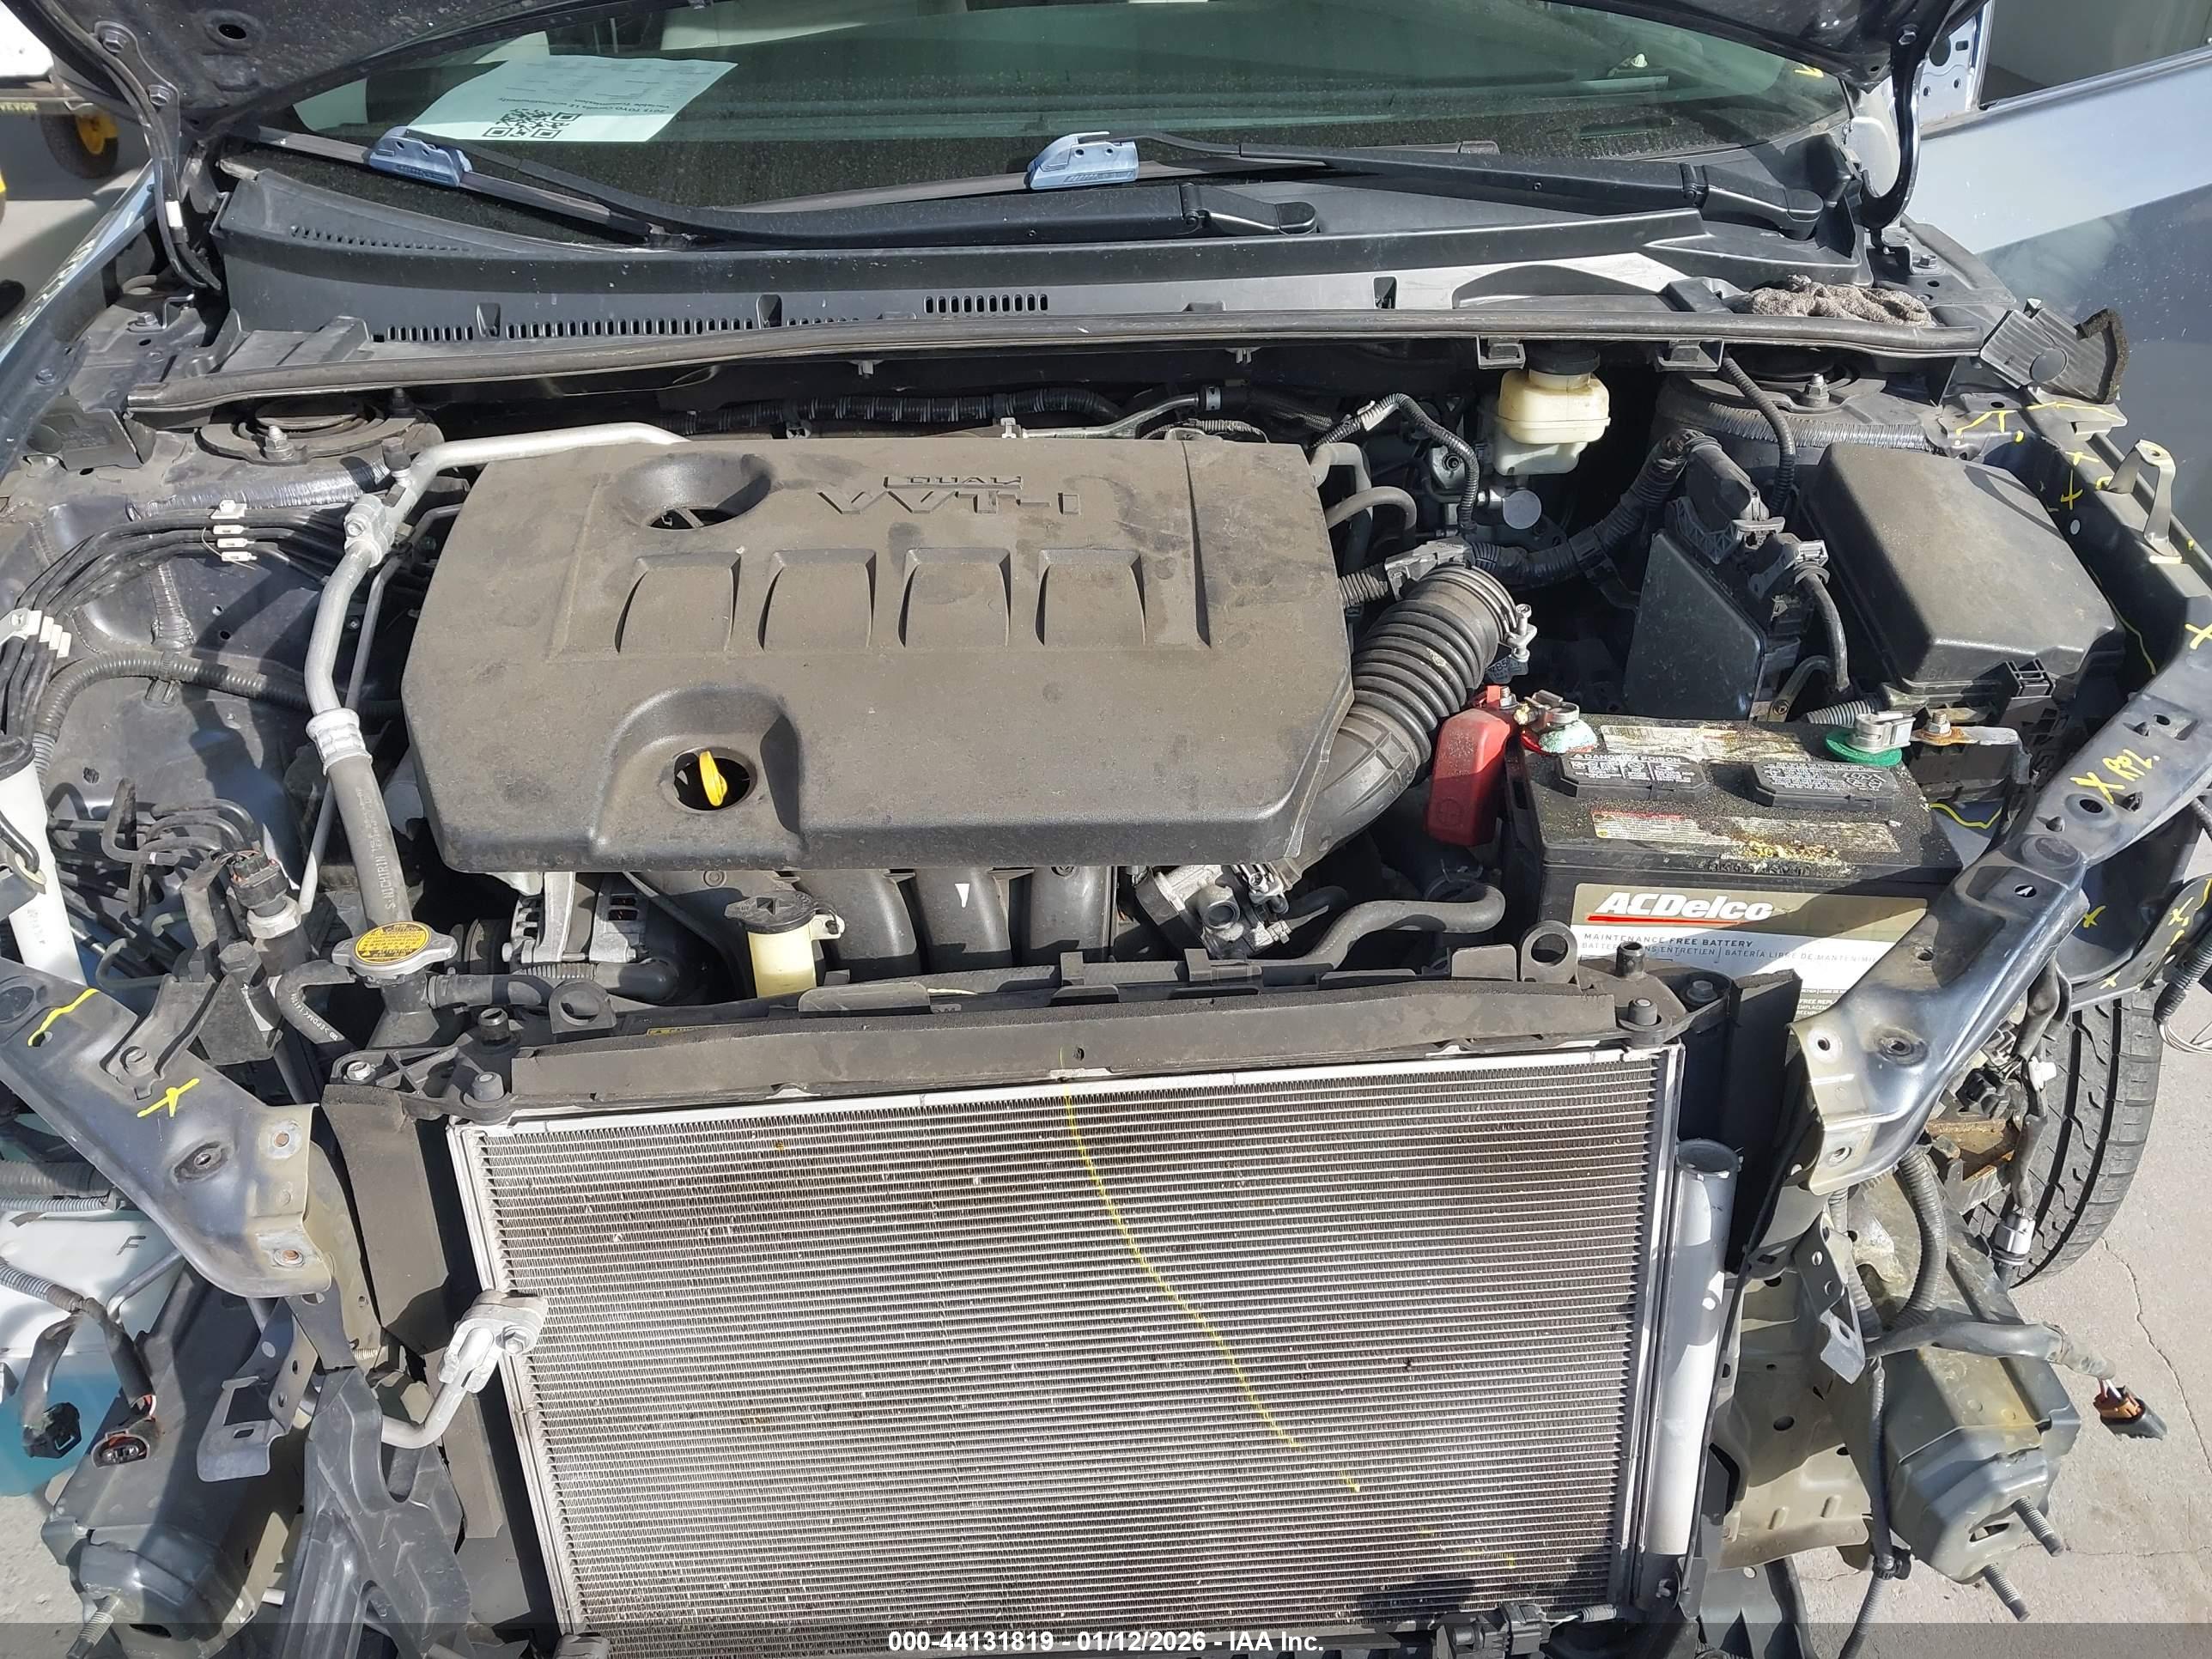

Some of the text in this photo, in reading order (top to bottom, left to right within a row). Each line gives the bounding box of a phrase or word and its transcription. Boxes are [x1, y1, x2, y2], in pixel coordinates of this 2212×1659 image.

[1594, 891, 1774, 921] ACDelco
[1583, 933, 1753, 948] MAINTENANCE FREE BATTERY
[1661, 946, 1715, 956] ENTRETIEN
[1724, 949, 1765, 958] BATERÍA
[117, 1236, 146, 1255] F
